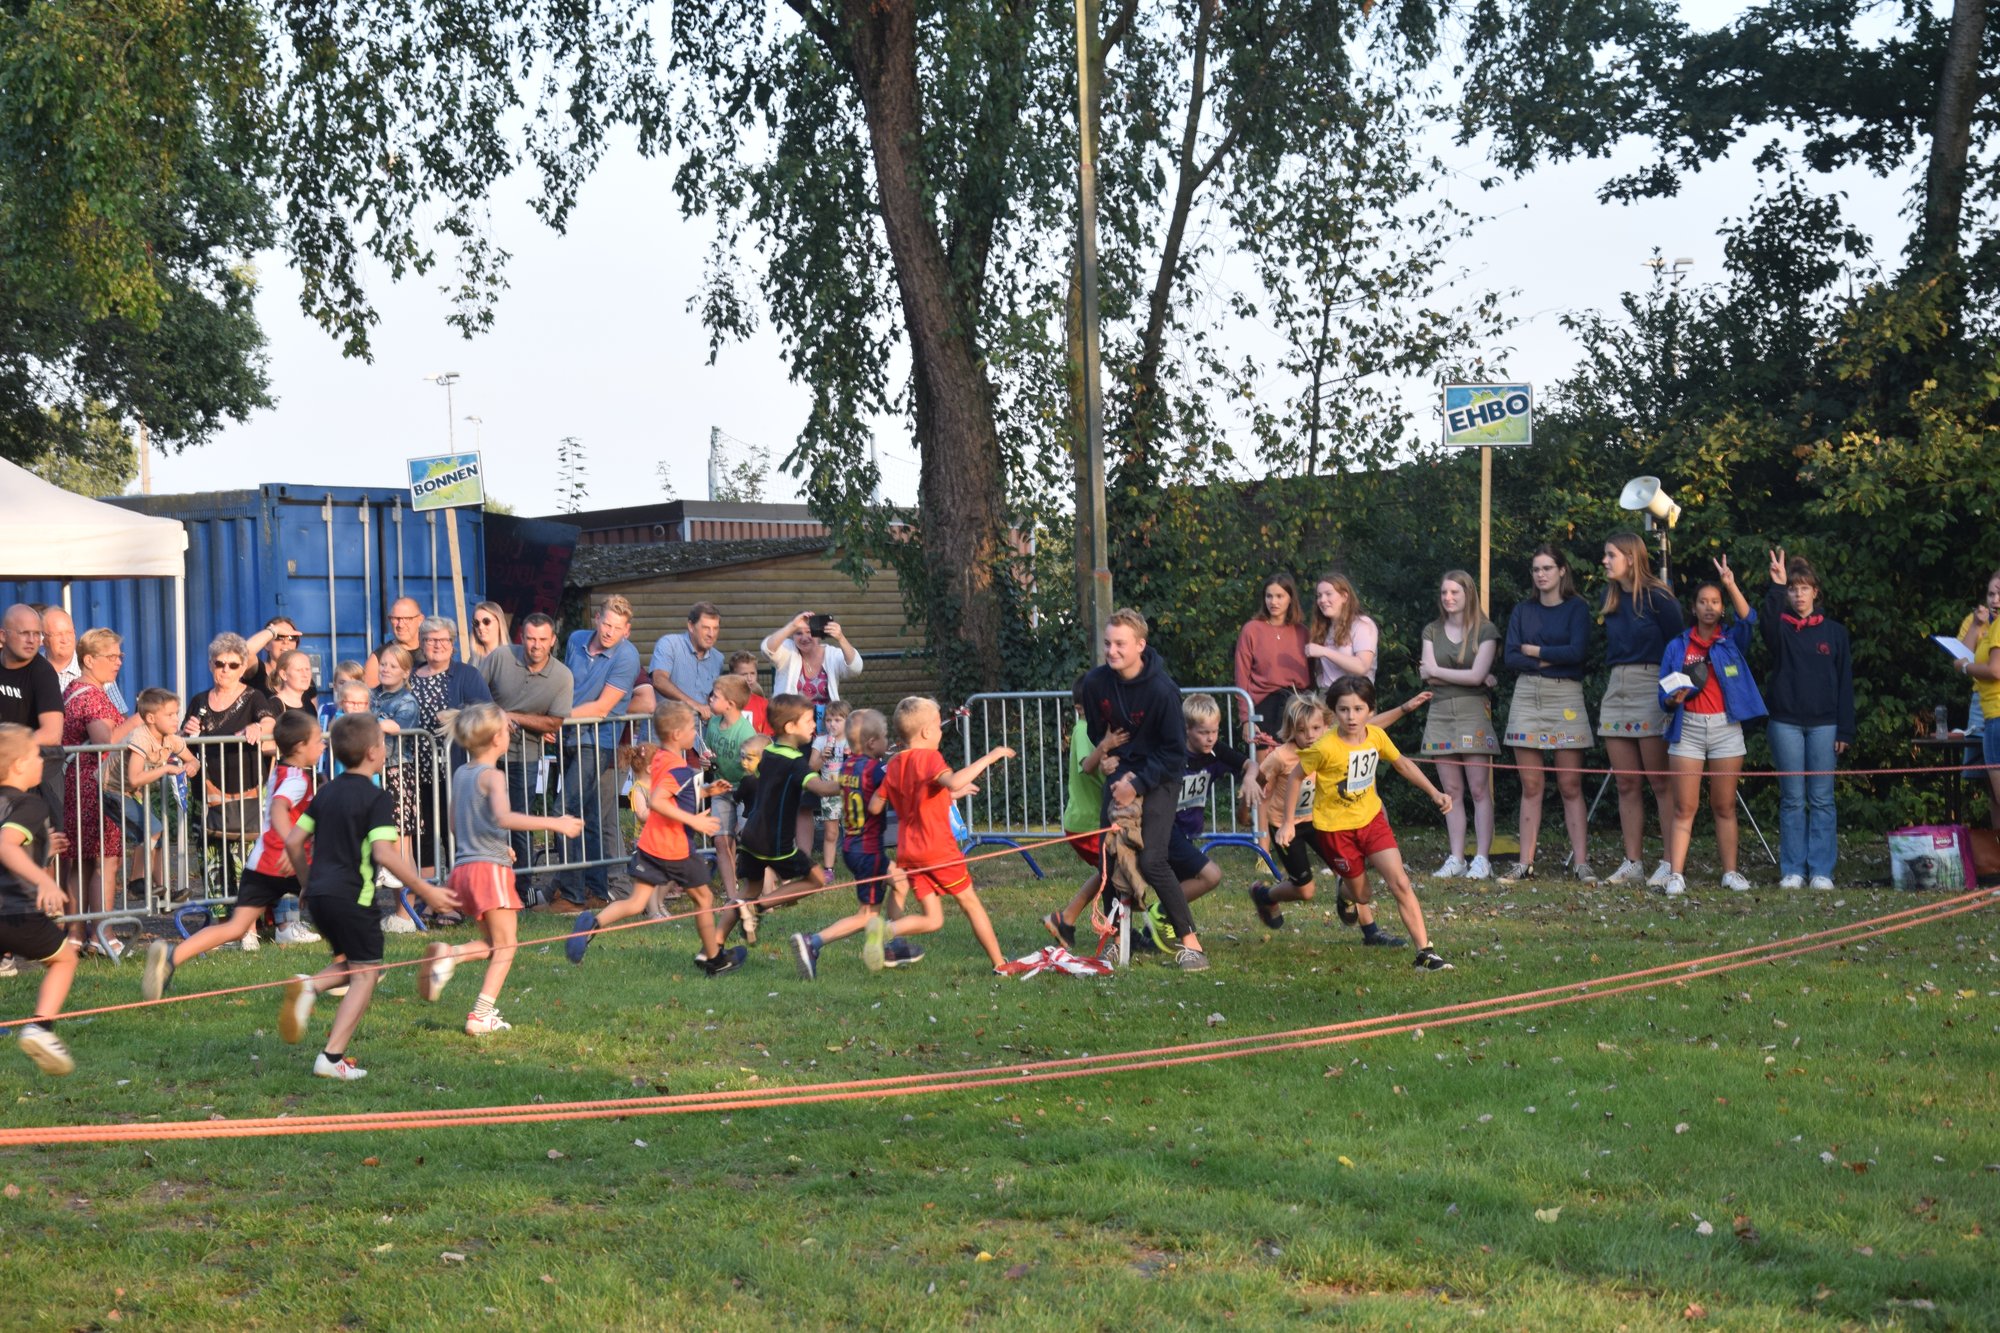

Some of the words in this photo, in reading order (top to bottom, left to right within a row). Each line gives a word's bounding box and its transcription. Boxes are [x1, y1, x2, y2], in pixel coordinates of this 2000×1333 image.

[1448, 394, 1529, 432] EHBO
[413, 464, 478, 496] BONNEN
[1352, 751, 1376, 778] 137
[1181, 776, 1206, 800] 143
[1300, 788, 1315, 807] 2
